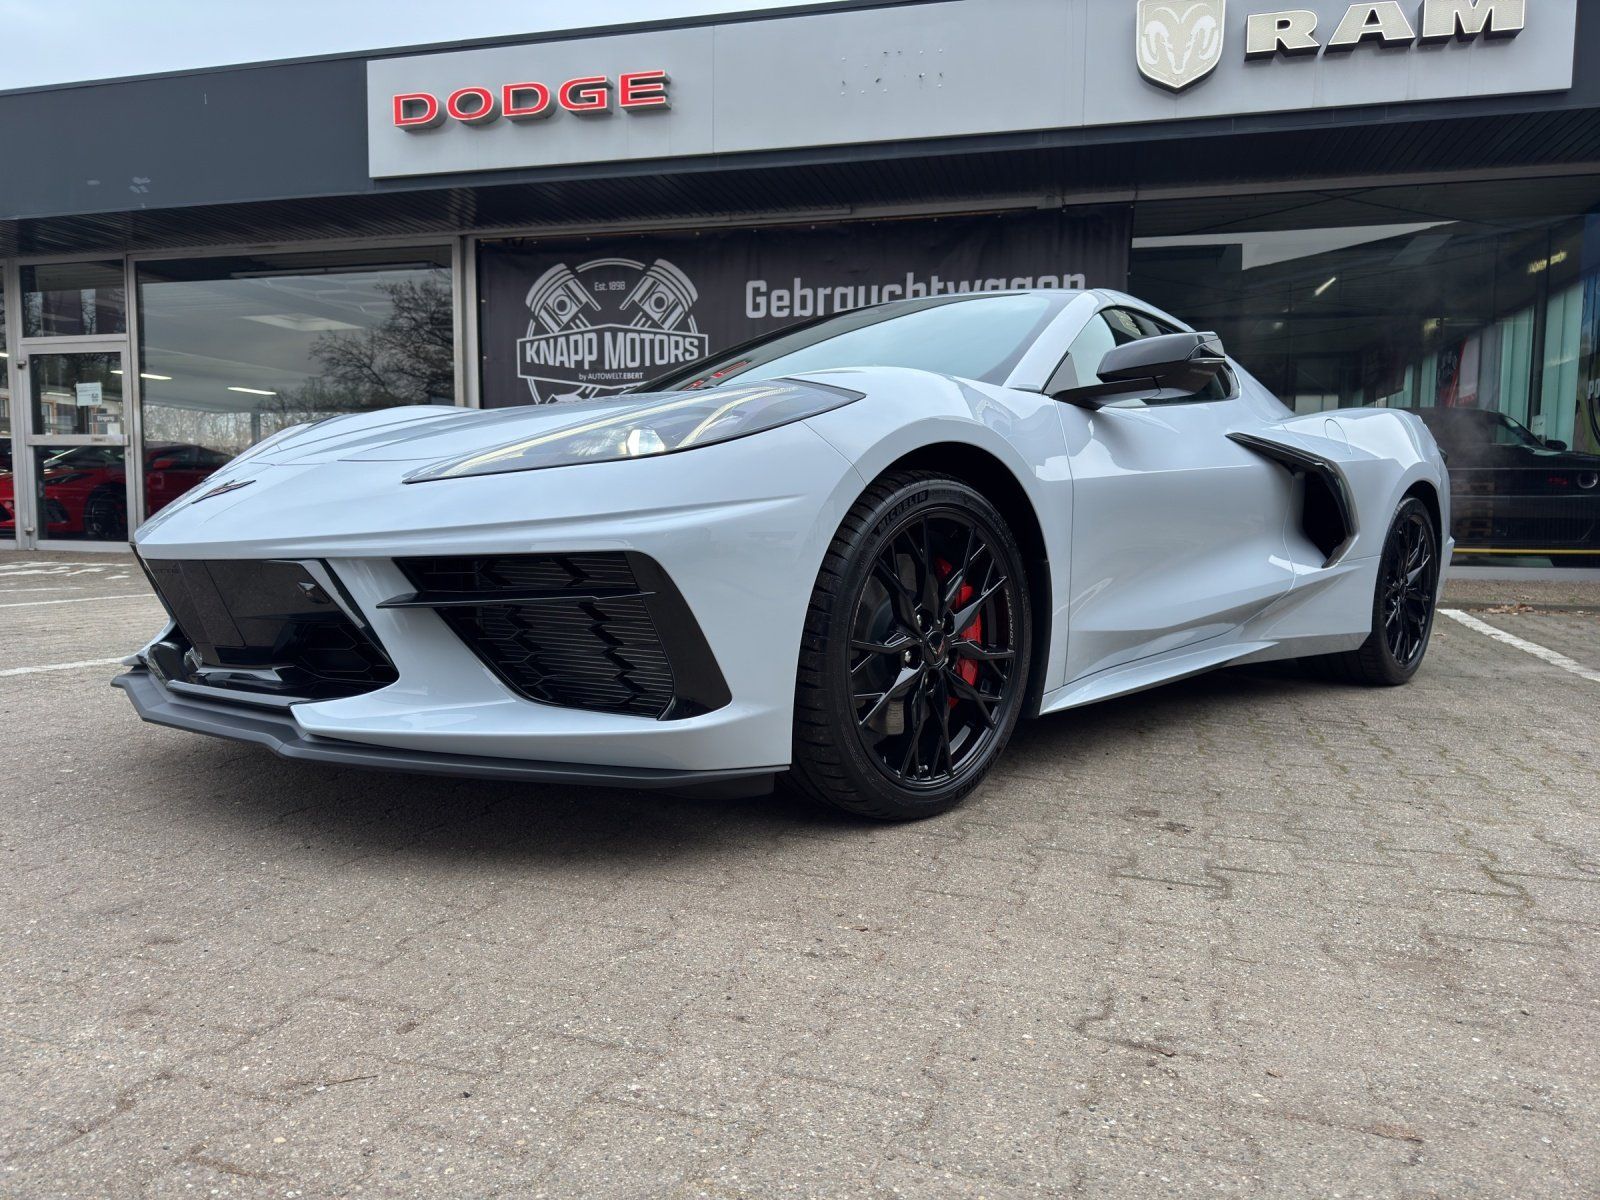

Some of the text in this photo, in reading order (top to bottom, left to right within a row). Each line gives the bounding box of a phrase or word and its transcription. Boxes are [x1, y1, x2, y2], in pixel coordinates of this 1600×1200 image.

[1246, 0, 1526, 54] RAM
[393, 69, 668, 127] DODGE
[525, 331, 699, 370] KNAPP MOTORS
[578, 373, 587, 381] by
